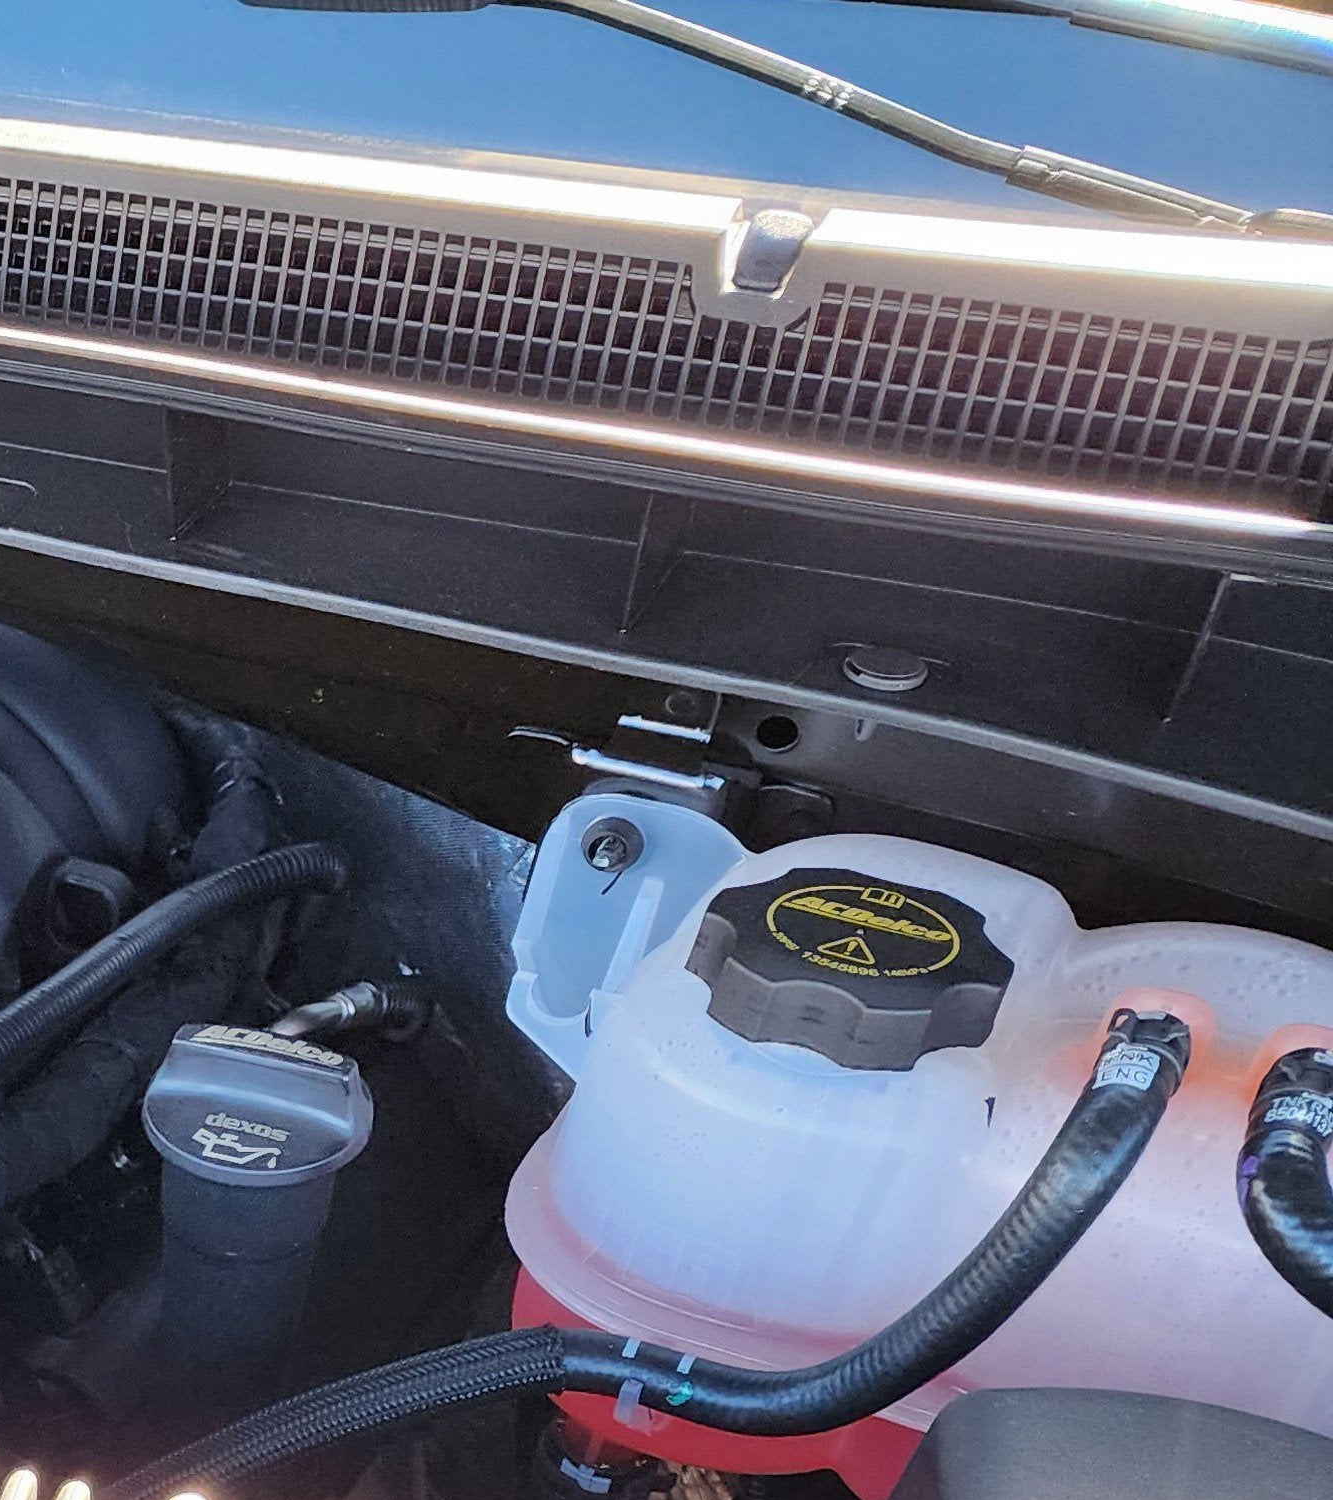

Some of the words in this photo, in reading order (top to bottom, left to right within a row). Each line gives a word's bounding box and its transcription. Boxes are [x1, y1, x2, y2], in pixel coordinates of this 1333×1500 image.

[788, 897, 952, 941] ACDelco
[190, 1025, 344, 1066] ACDelco
[1101, 1068, 1149, 1084] ENG
[205, 1112, 291, 1142] dexos
